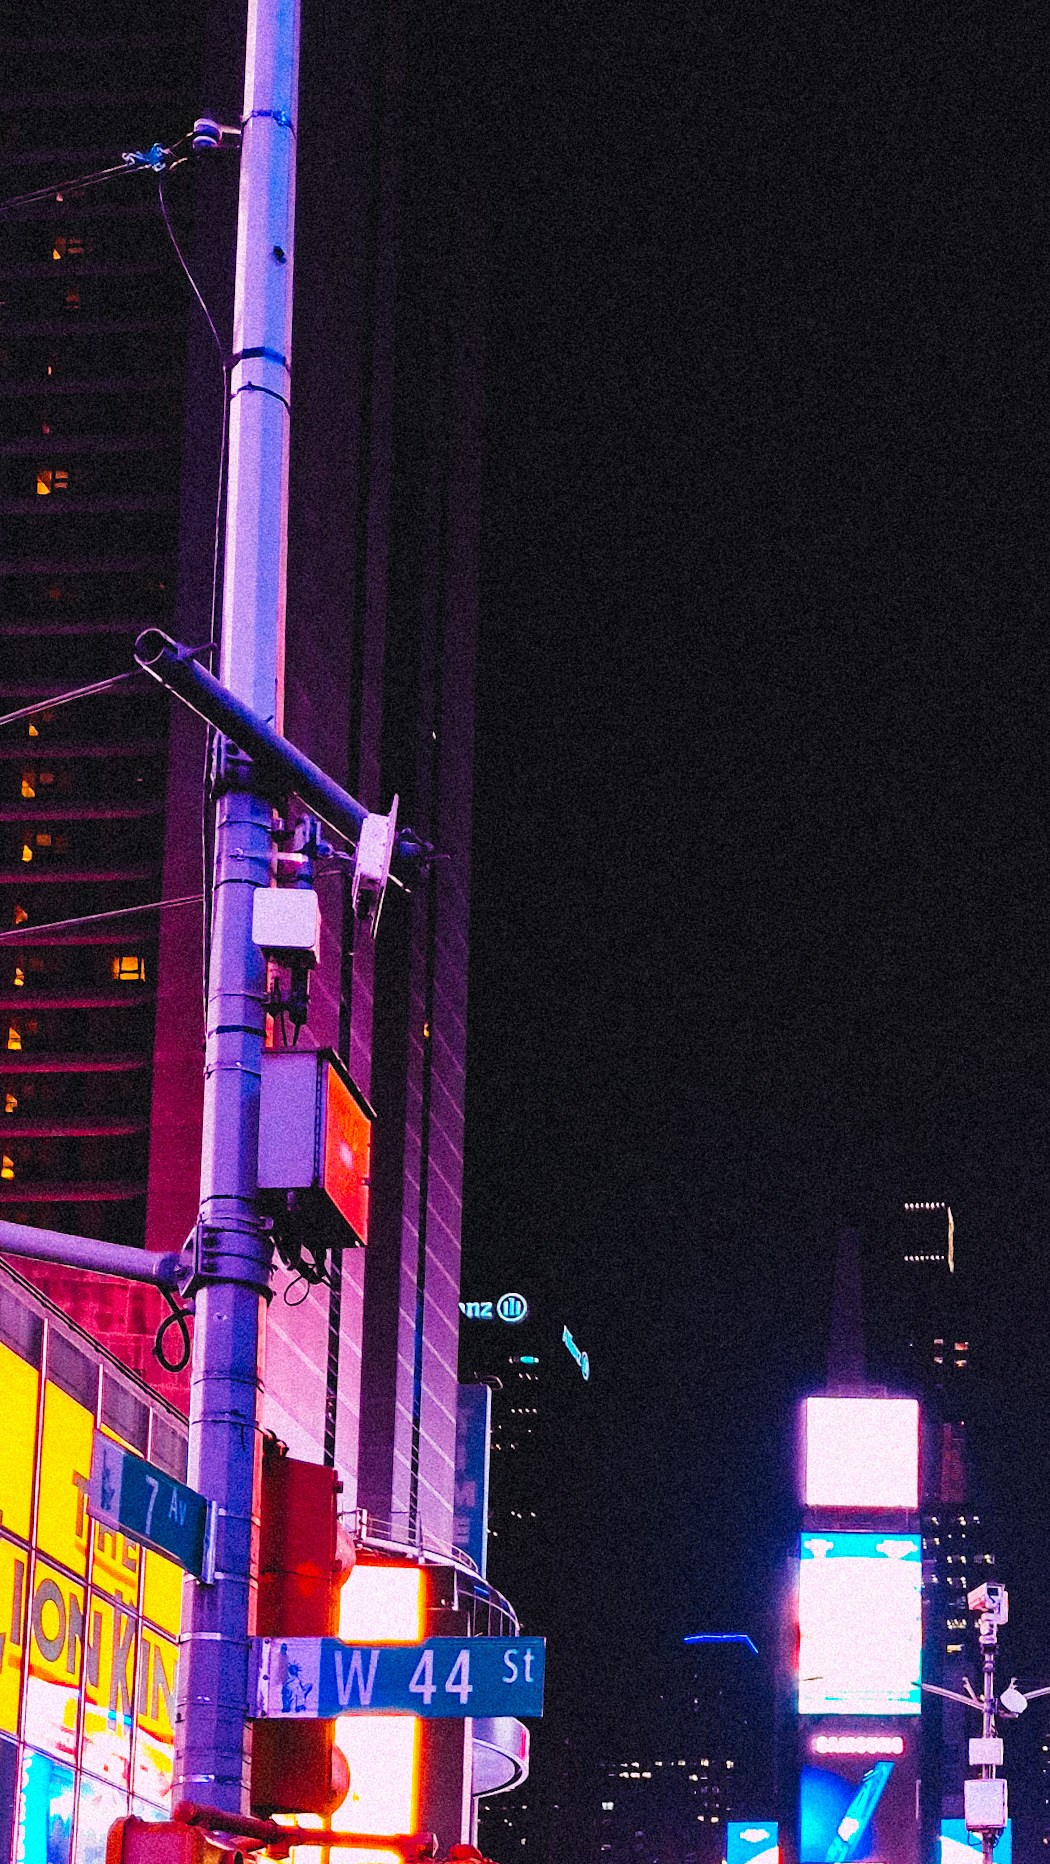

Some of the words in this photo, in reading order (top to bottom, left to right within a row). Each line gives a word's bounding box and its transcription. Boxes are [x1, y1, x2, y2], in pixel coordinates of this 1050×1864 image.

[146, 1474, 159, 1535] 7
[0, 1557, 101, 1691] ION
[335, 1649, 380, 1705] W
[408, 1649, 473, 1704] 44
[501, 1648, 534, 1684] St
